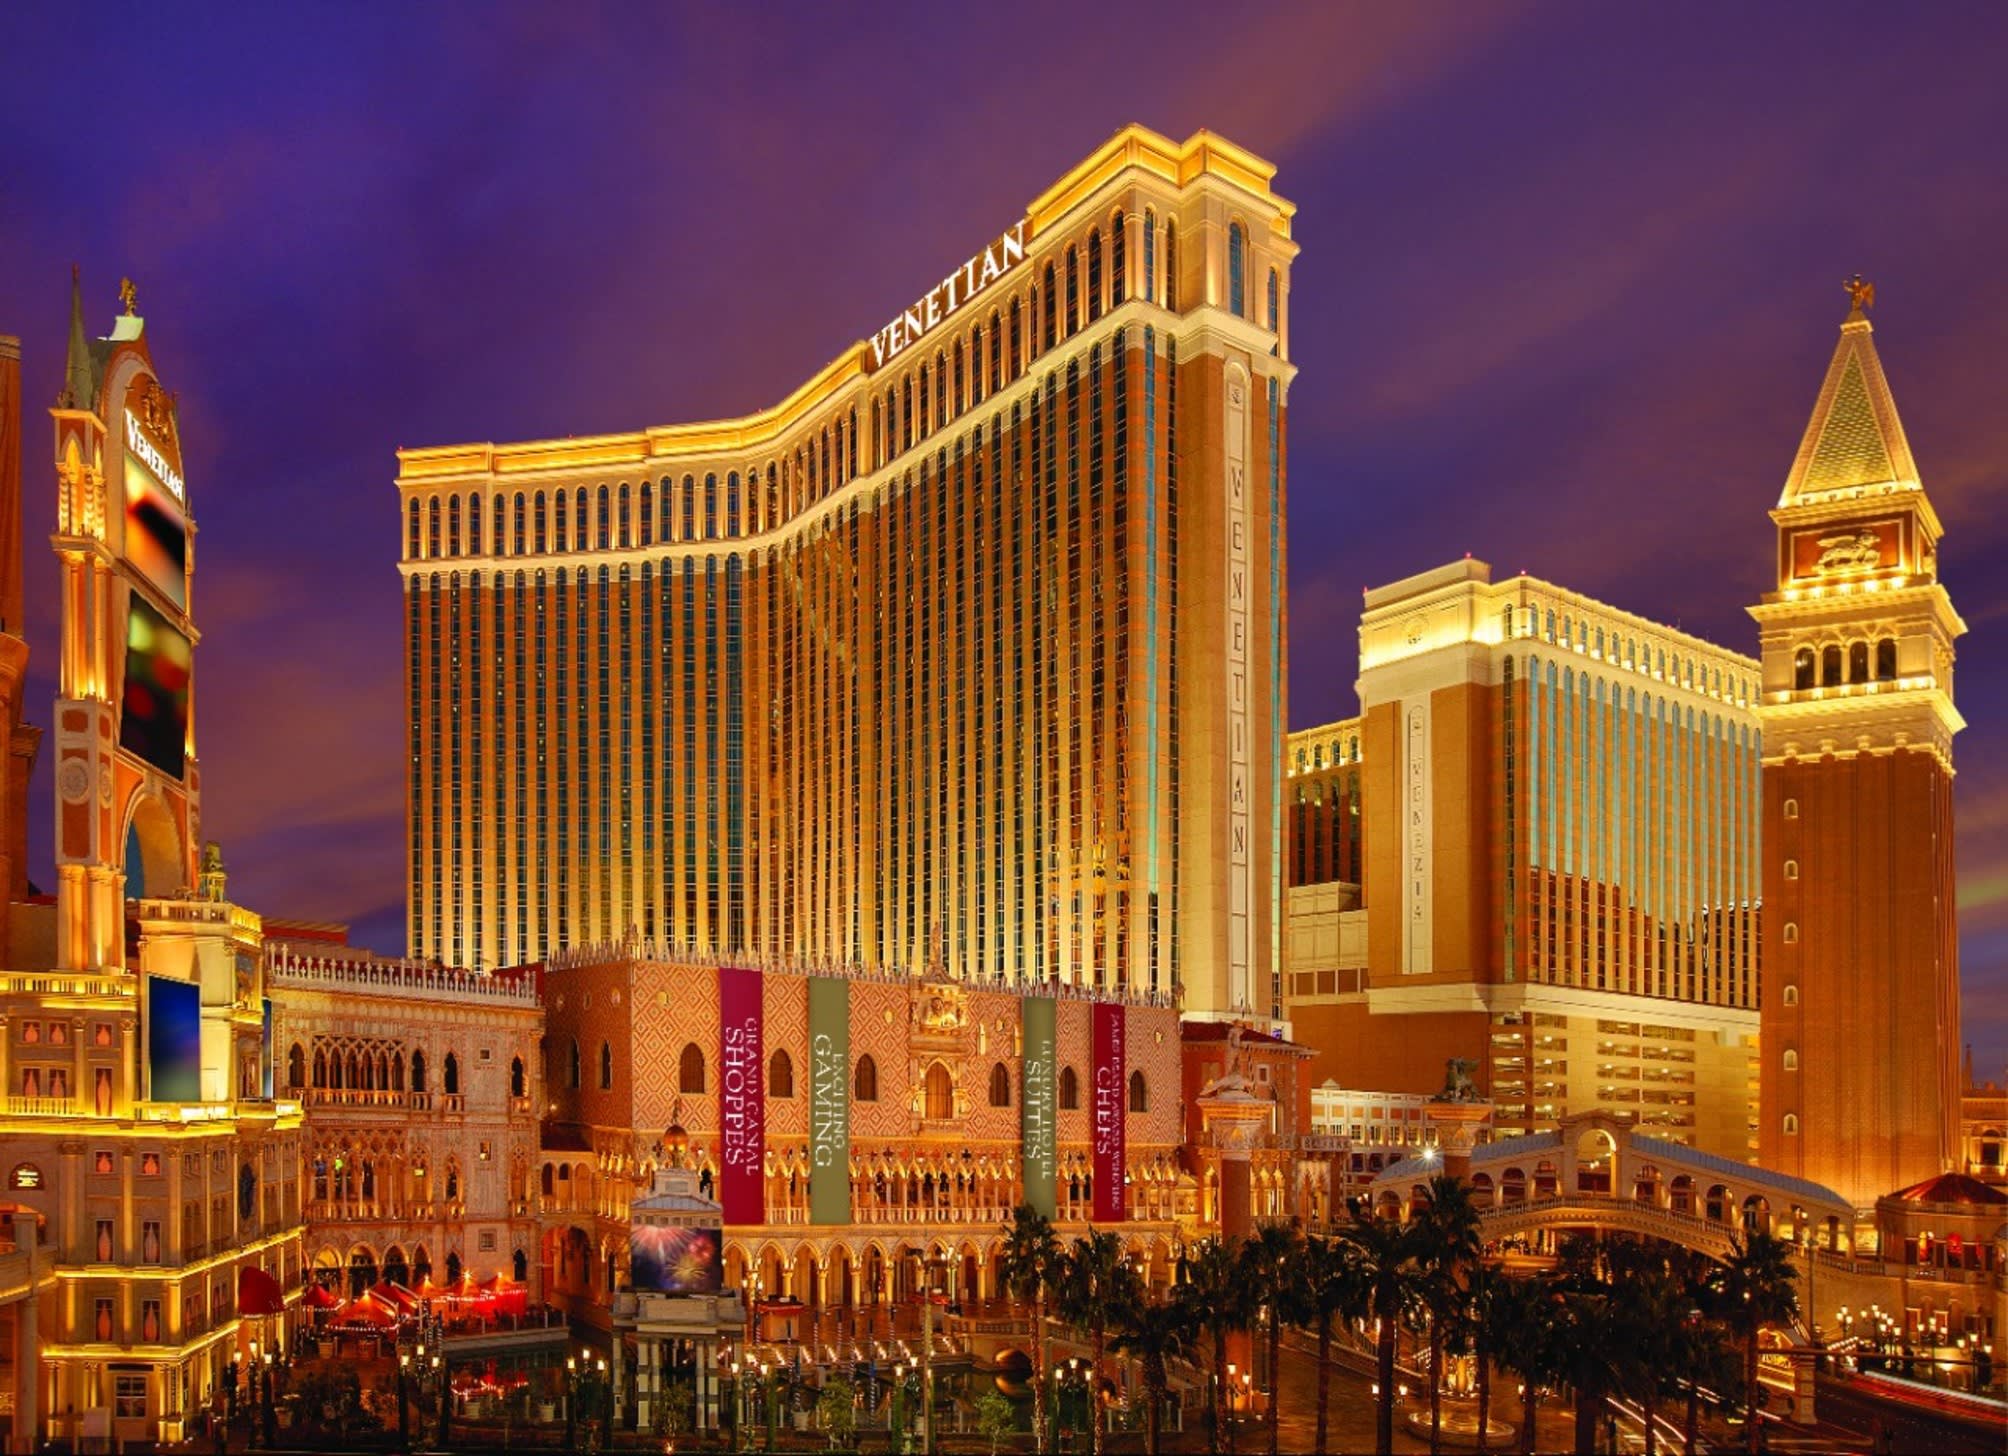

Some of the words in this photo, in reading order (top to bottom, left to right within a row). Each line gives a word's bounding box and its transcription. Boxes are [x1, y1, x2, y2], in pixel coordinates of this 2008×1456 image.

[868, 218, 1027, 368] VENETIAN
[124, 407, 184, 504] VENETIAN
[1231, 466, 1244, 853] VENETIAN
[725, 1026, 745, 1165] SHOPPES
[745, 1017, 758, 1095] GRAND
[814, 1034, 832, 1167] GAMING
[833, 1053, 845, 1149] EXCITING
[1042, 1040, 1052, 1112] LUXURY
[746, 1101, 759, 1176] CANAL
[1026, 1060, 1041, 1160] SUITES
[1042, 1119, 1053, 1180] HOTEL
[1097, 1066, 1112, 1154] CHEFS
